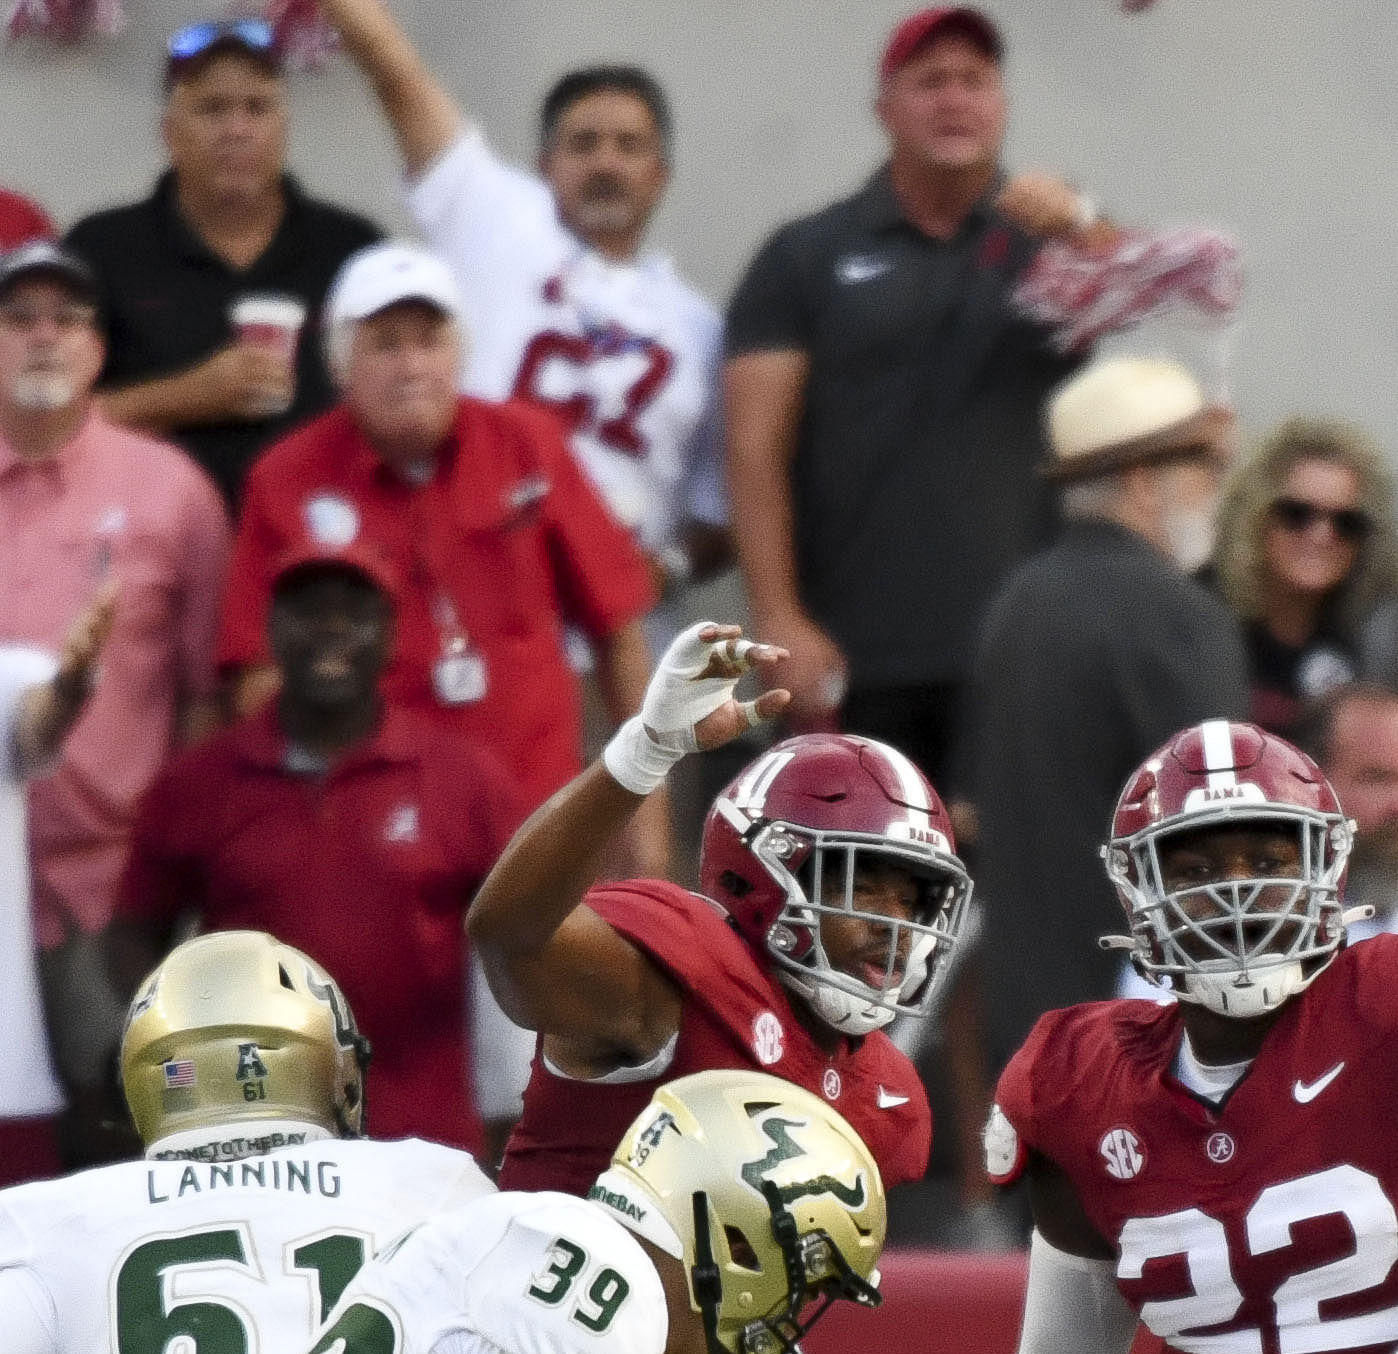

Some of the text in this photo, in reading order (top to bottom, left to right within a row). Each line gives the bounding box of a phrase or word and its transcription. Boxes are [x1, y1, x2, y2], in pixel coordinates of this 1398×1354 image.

[241, 1080, 267, 1102] 61
[1100, 1128, 1143, 1180] SEC
[148, 1159, 341, 1204] LANNING
[529, 1236, 631, 1333] 39
